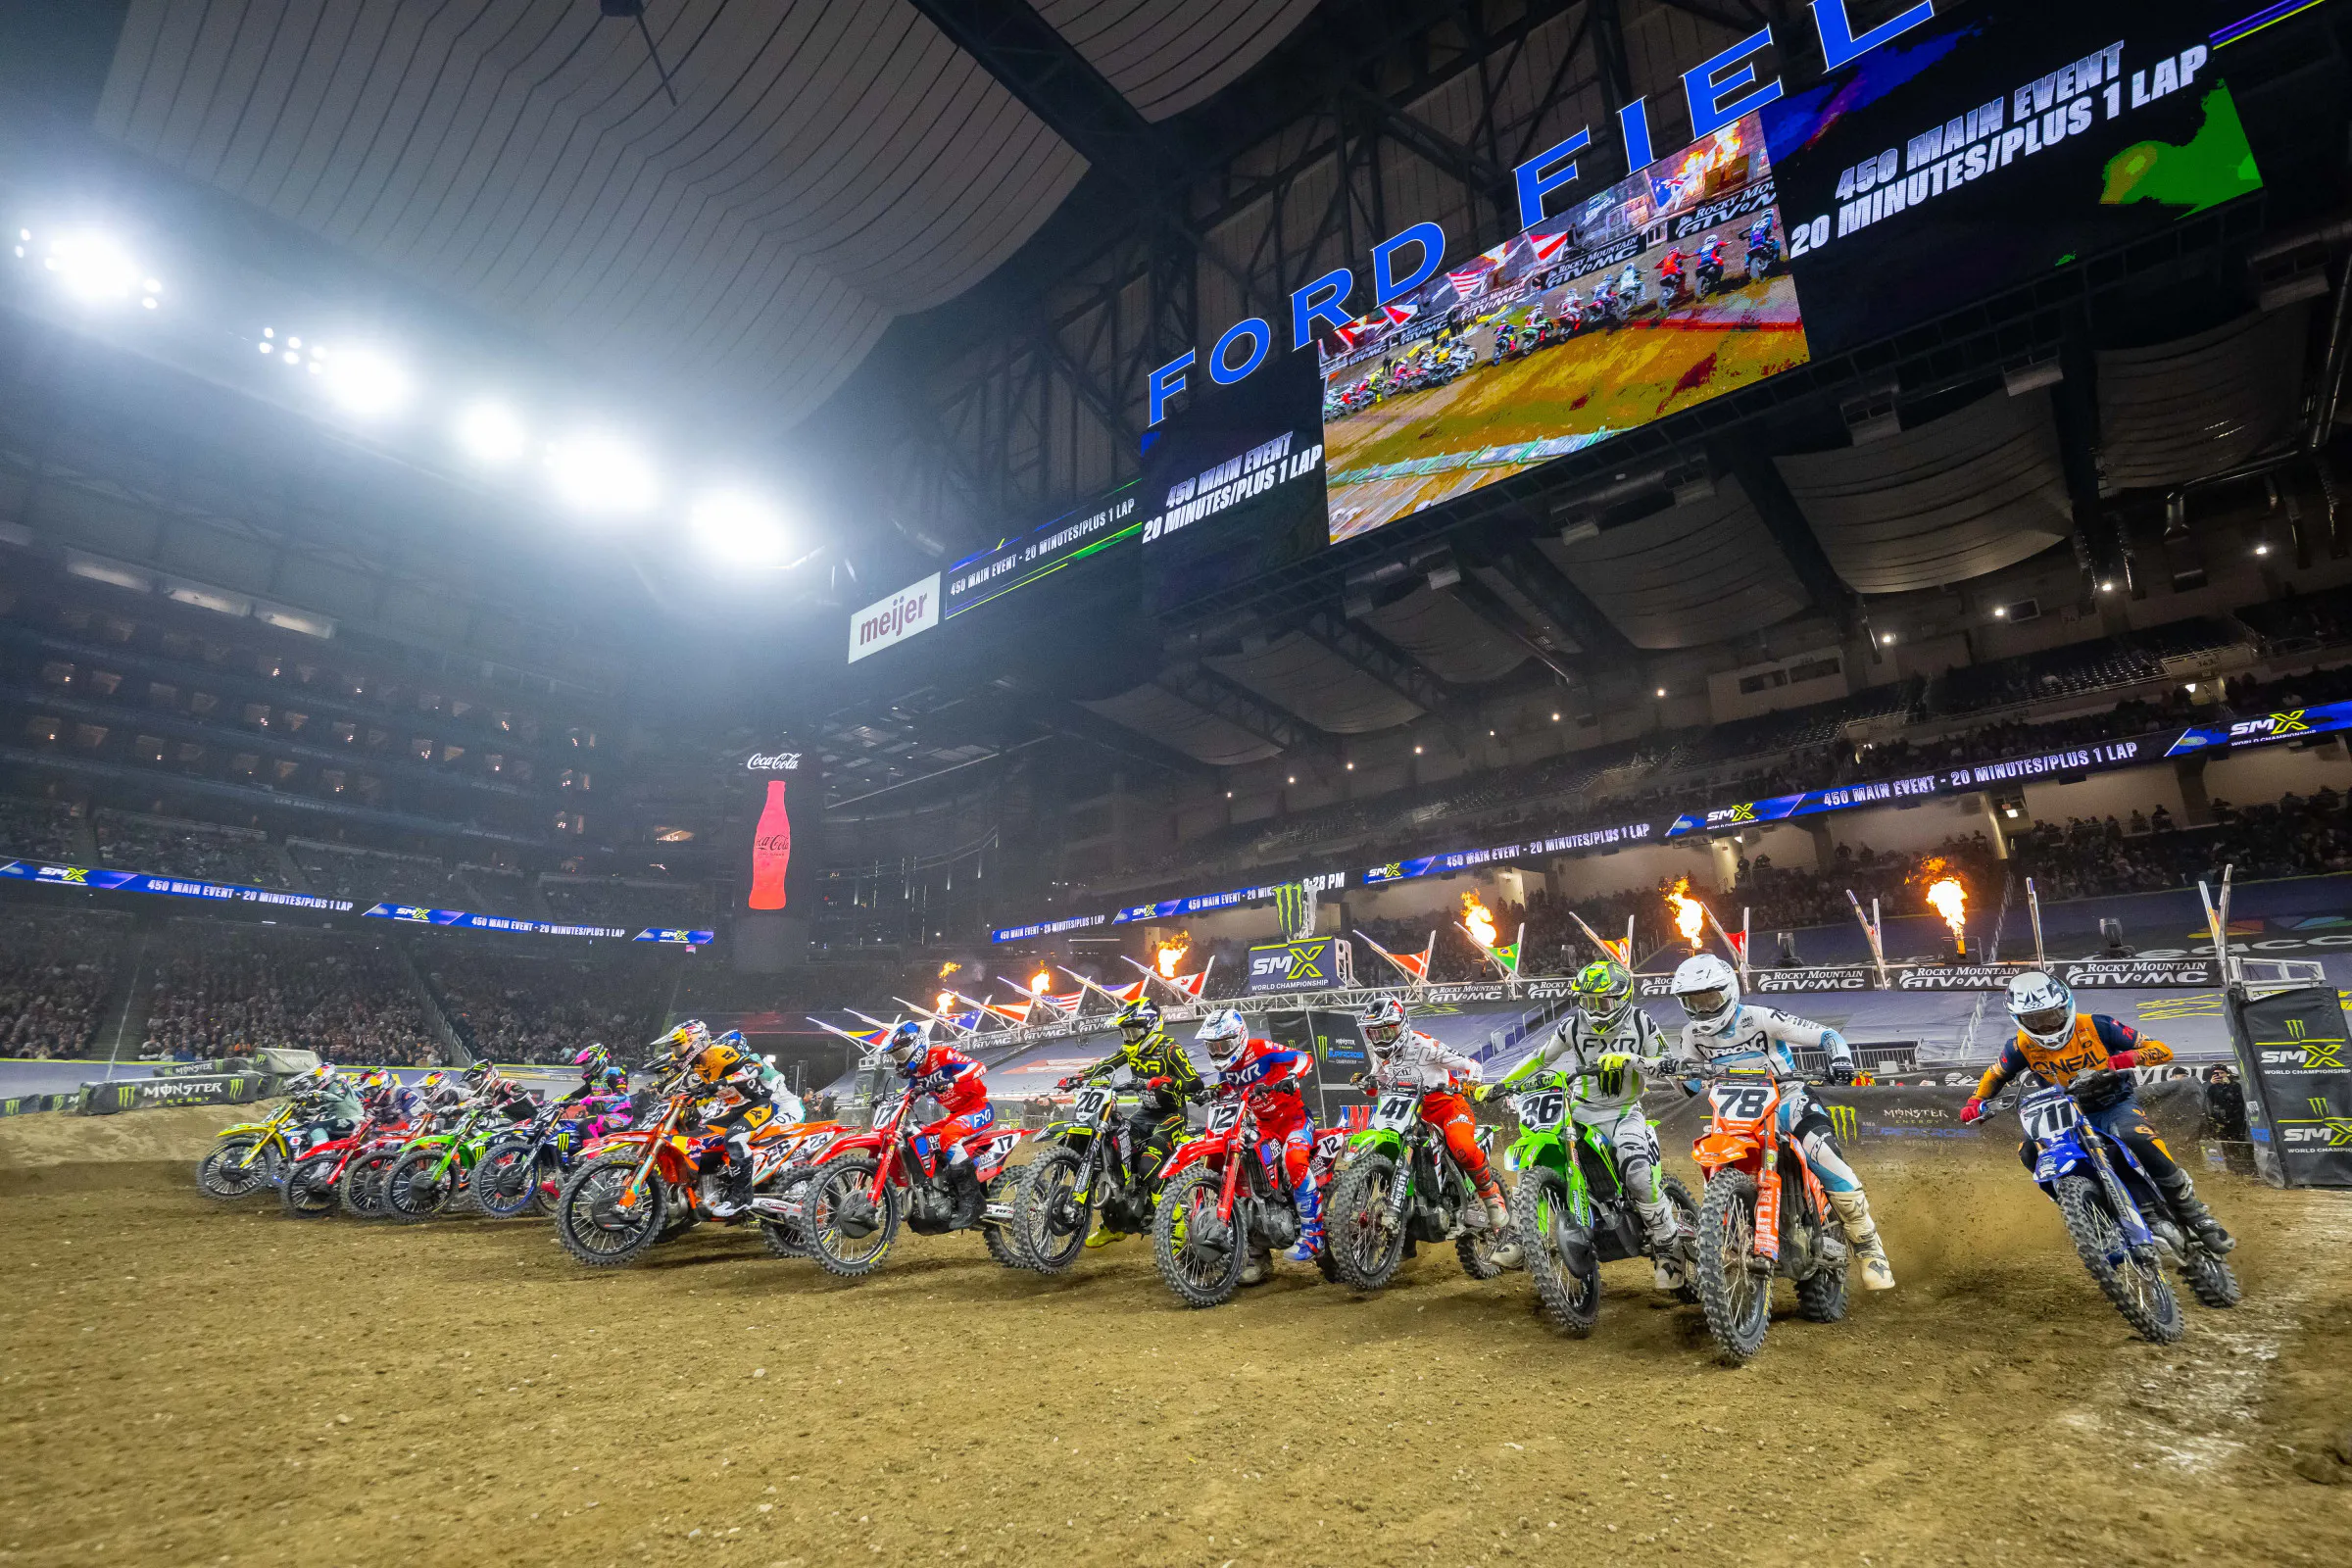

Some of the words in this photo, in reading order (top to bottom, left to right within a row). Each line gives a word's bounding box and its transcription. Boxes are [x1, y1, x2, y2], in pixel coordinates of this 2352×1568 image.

[1835, 148, 1898, 200] 450
[1907, 96, 2003, 172] MAIN
[2014, 40, 2124, 122] EVENT
[1790, 215, 1831, 259] 20
[1838, 95, 2092, 238] MINUTES/PLUS
[2103, 81, 2121, 120] 1
[2132, 44, 2207, 109] LAP
[1695, 198, 1738, 219] ROCKY
[1559, 255, 1585, 271] ROCKY
[1587, 236, 1638, 264] MOUNTAIN
[1148, 220, 1446, 427] FORD
[1166, 477, 1196, 509] 450
[1198, 455, 1243, 496] MAIN
[1244, 431, 1293, 474] EVENT
[1143, 516, 1162, 544] 20
[1164, 466, 1275, 534] MINUTES/PLUS
[1280, 459, 1288, 484] 1
[1290, 444, 1322, 479] LAP
[951, 578, 965, 596] 450
[968, 567, 989, 588] MAIN
[992, 554, 1017, 577] EVENT
[1025, 544, 1037, 562] 20
[1039, 511, 1105, 556] MINUTES/PLUS
[1108, 508, 1113, 522] 1
[1116, 498, 1135, 519] LAP
[859, 592, 928, 646] meijer
[2230, 710, 2310, 735] SMX
[1824, 793, 1848, 807] 450
[1853, 783, 1889, 802] MAIN
[1894, 775, 1935, 795] EVENT
[1951, 769, 1970, 786] 20
[1974, 745, 2089, 784] MINUTES/PLUS
[2093, 748, 2103, 762] 1
[2107, 742, 2137, 761] LAP
[1707, 803, 1756, 821] SMX
[1466, 851, 1491, 865] MAIN
[1493, 845, 1521, 860] EVENT
[1530, 841, 1544, 855] 20
[1545, 829, 1619, 853] MINUTES/PLUS
[1621, 827, 1627, 838] 1
[1629, 823, 1649, 838] LAP
[38, 867, 89, 882] SMX
[1328, 872, 1345, 889] PM
[1368, 862, 1401, 878] SMX
[148, 880, 169, 892] 450
[172, 882, 201, 895] MAIN
[203, 885, 234, 899] EVENT
[243, 890, 257, 901] 20
[259, 892, 327, 909] MINUTES/PLUS
[329, 900, 334, 909] 1
[336, 901, 354, 911] LAP
[1188, 898, 1201, 910] 450
[1202, 895, 1219, 908] MAIN
[1221, 892, 1241, 906] EVENT
[1247, 889, 1256, 901] 20
[396, 907, 431, 919] SMX
[1133, 904, 1157, 917] SMX
[471, 916, 487, 926] 450
[489, 918, 510, 928] MAIN
[512, 921, 533, 931] EVENT
[540, 924, 550, 933] 20
[612, 928, 625, 938] LAP
[660, 930, 689, 941] SMX
[1025, 925, 1039, 937] EVENT
[1095, 914, 1105, 924] LAP
[1251, 945, 1325, 980] SMX
[1917, 967, 1953, 977] ROCKY
[1956, 966, 2021, 976] MOUNTAIN
[2088, 963, 2132, 972] ROCKY
[2133, 962, 2207, 971] MOUNTAIN
[1276, 980, 1328, 989] CHAMPIONSHIP
[1774, 971, 1808, 981] ROCKY
[1810, 970, 1864, 979] MOUNTAIN
[1583, 1038, 1637, 1053] FXR
[2261, 1045, 2344, 1068] SMX
[175, 1063, 213, 1075] MONSTER
[1129, 1057, 1160, 1073] FXR
[1226, 1063, 1260, 1085] FXR
[2033, 1051, 2107, 1075] O'NEAL
[144, 1083, 222, 1097] MONSTER
[1076, 1092, 1104, 1112] 20
[1380, 1098, 1413, 1120] 41
[1521, 1094, 1563, 1126] 36
[1717, 1089, 1768, 1118] 78
[874, 1103, 900, 1125] 17
[1210, 1105, 1240, 1128] 12
[1884, 1108, 1948, 1119] MONSTER
[2024, 1102, 2073, 1140] 711
[998, 1135, 1013, 1152] 17
[2283, 1122, 2352, 1146] SMX
[1323, 1137, 1340, 1154] 12
